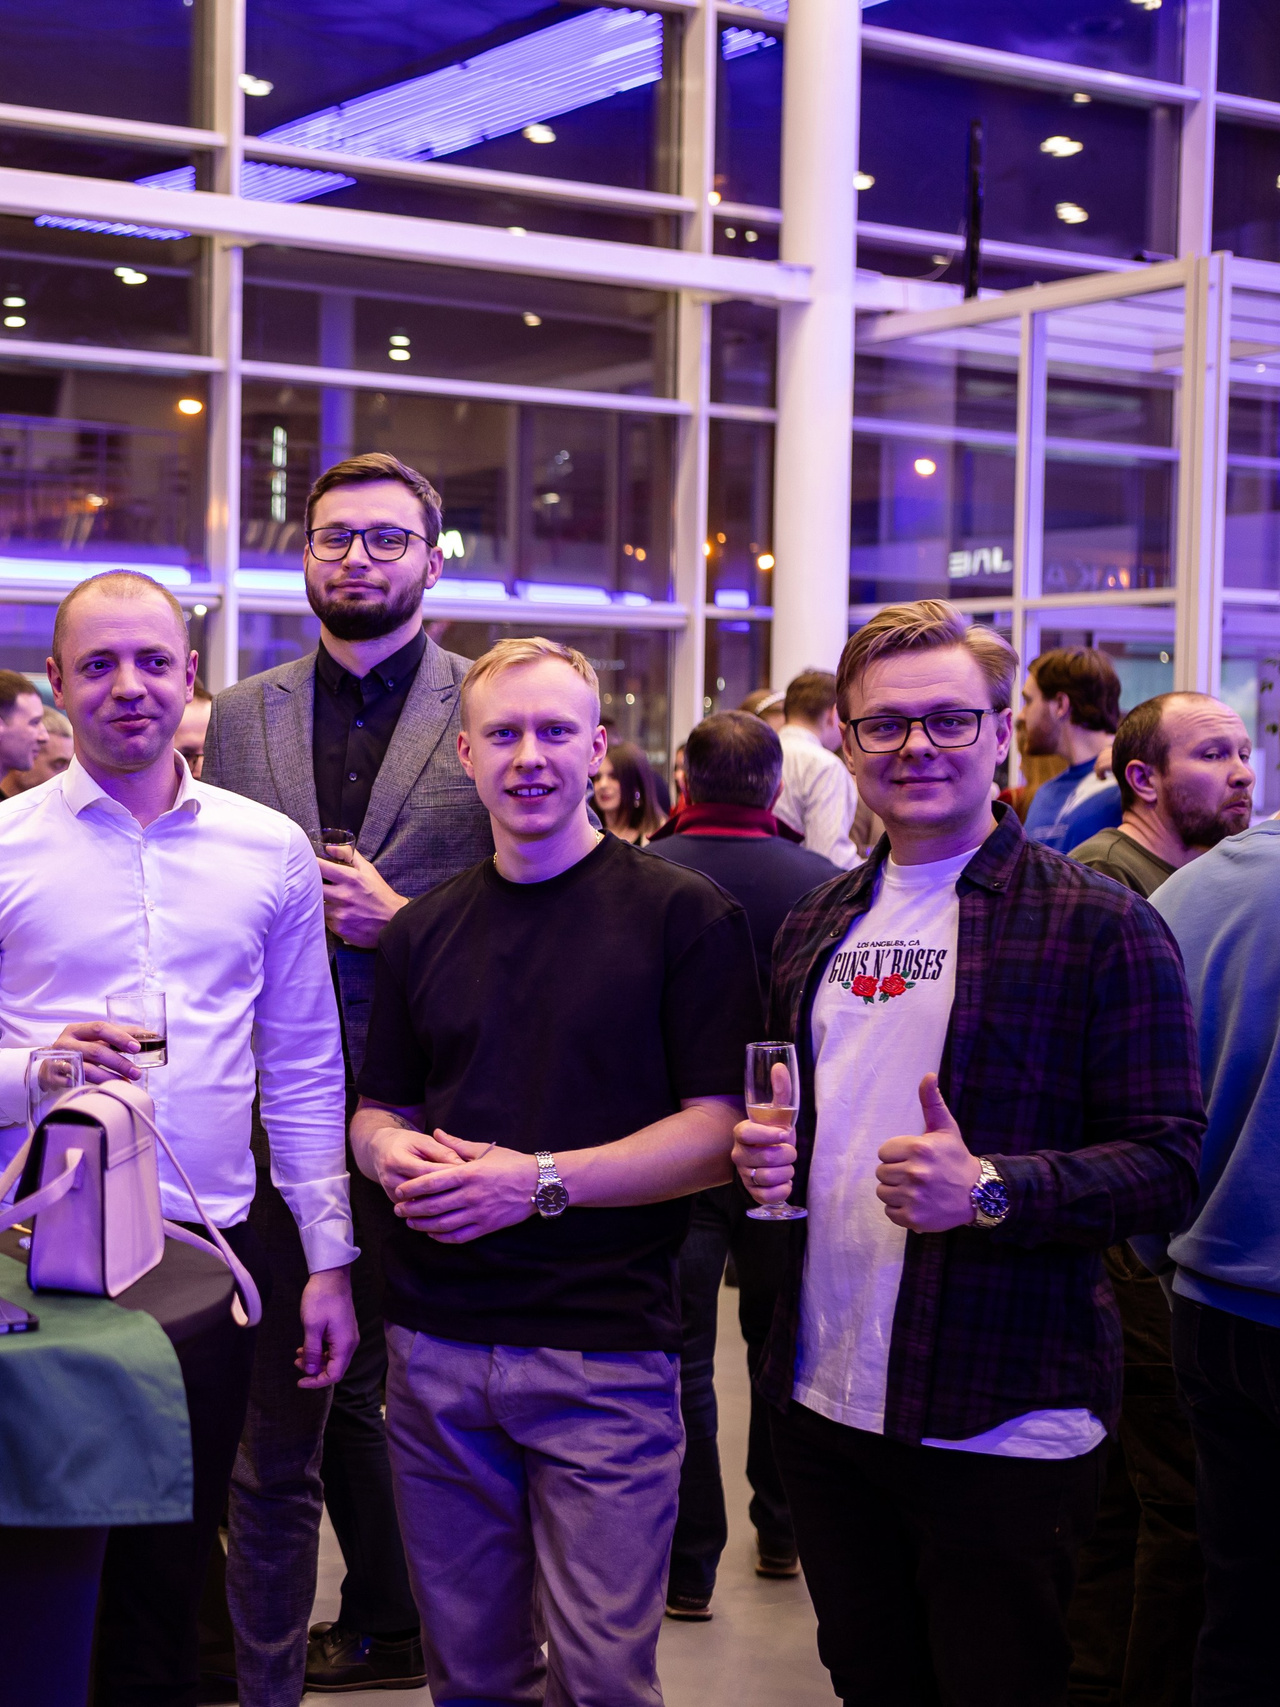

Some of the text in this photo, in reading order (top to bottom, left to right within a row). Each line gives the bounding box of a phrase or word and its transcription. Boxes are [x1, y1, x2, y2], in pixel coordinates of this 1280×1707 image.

[871, 940, 907, 948] ANGELES,
[828, 950, 870, 983] GUNS
[890, 948, 948, 980] ROSES
